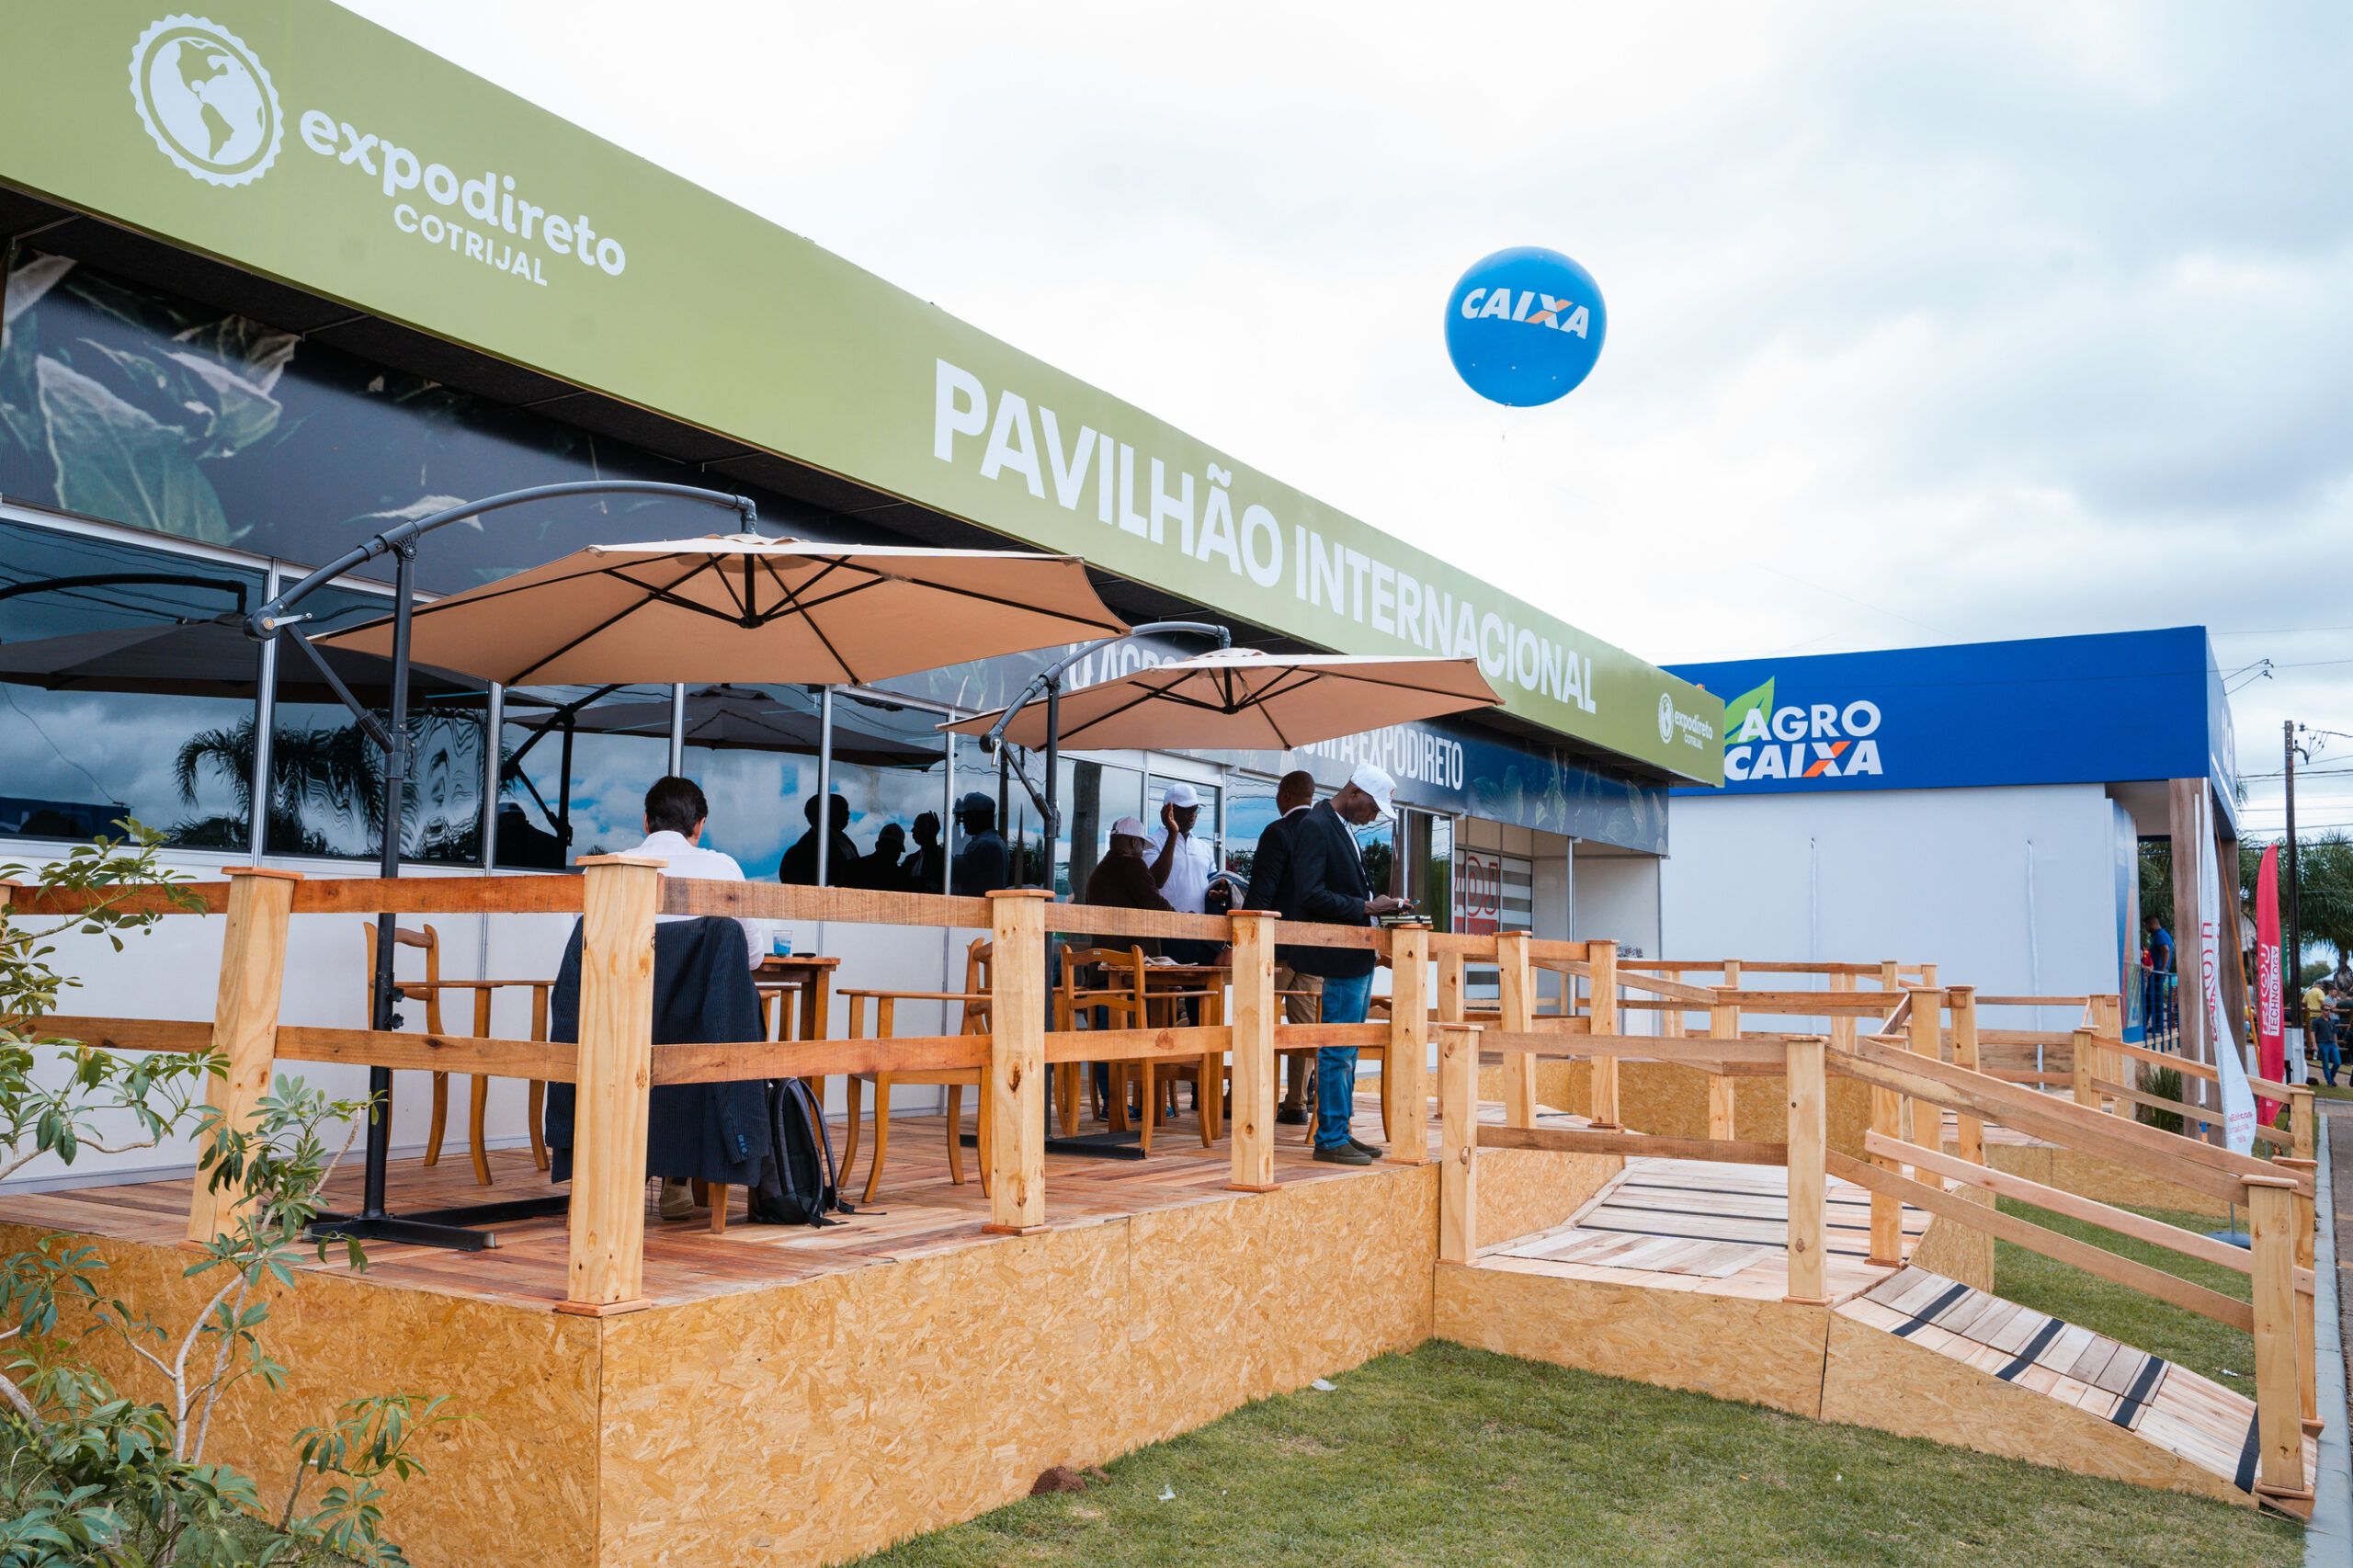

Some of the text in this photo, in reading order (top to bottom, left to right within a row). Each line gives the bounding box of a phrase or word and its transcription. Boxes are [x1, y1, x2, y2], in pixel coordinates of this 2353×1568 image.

[300, 109, 626, 276] expodireto
[394, 203, 548, 287] COTRIJAL
[1461, 288, 1589, 339] CAIXA
[934, 358, 1597, 714] PAVILHÃO INTERNACIONAL
[1675, 710, 1713, 741] expodireto
[1737, 700, 1881, 742] AGRO
[1358, 725, 1464, 790] EXPODIRETO
[1724, 740, 1883, 781] CAIXA
[2270, 947, 2279, 1034] TECHNOLOGY
